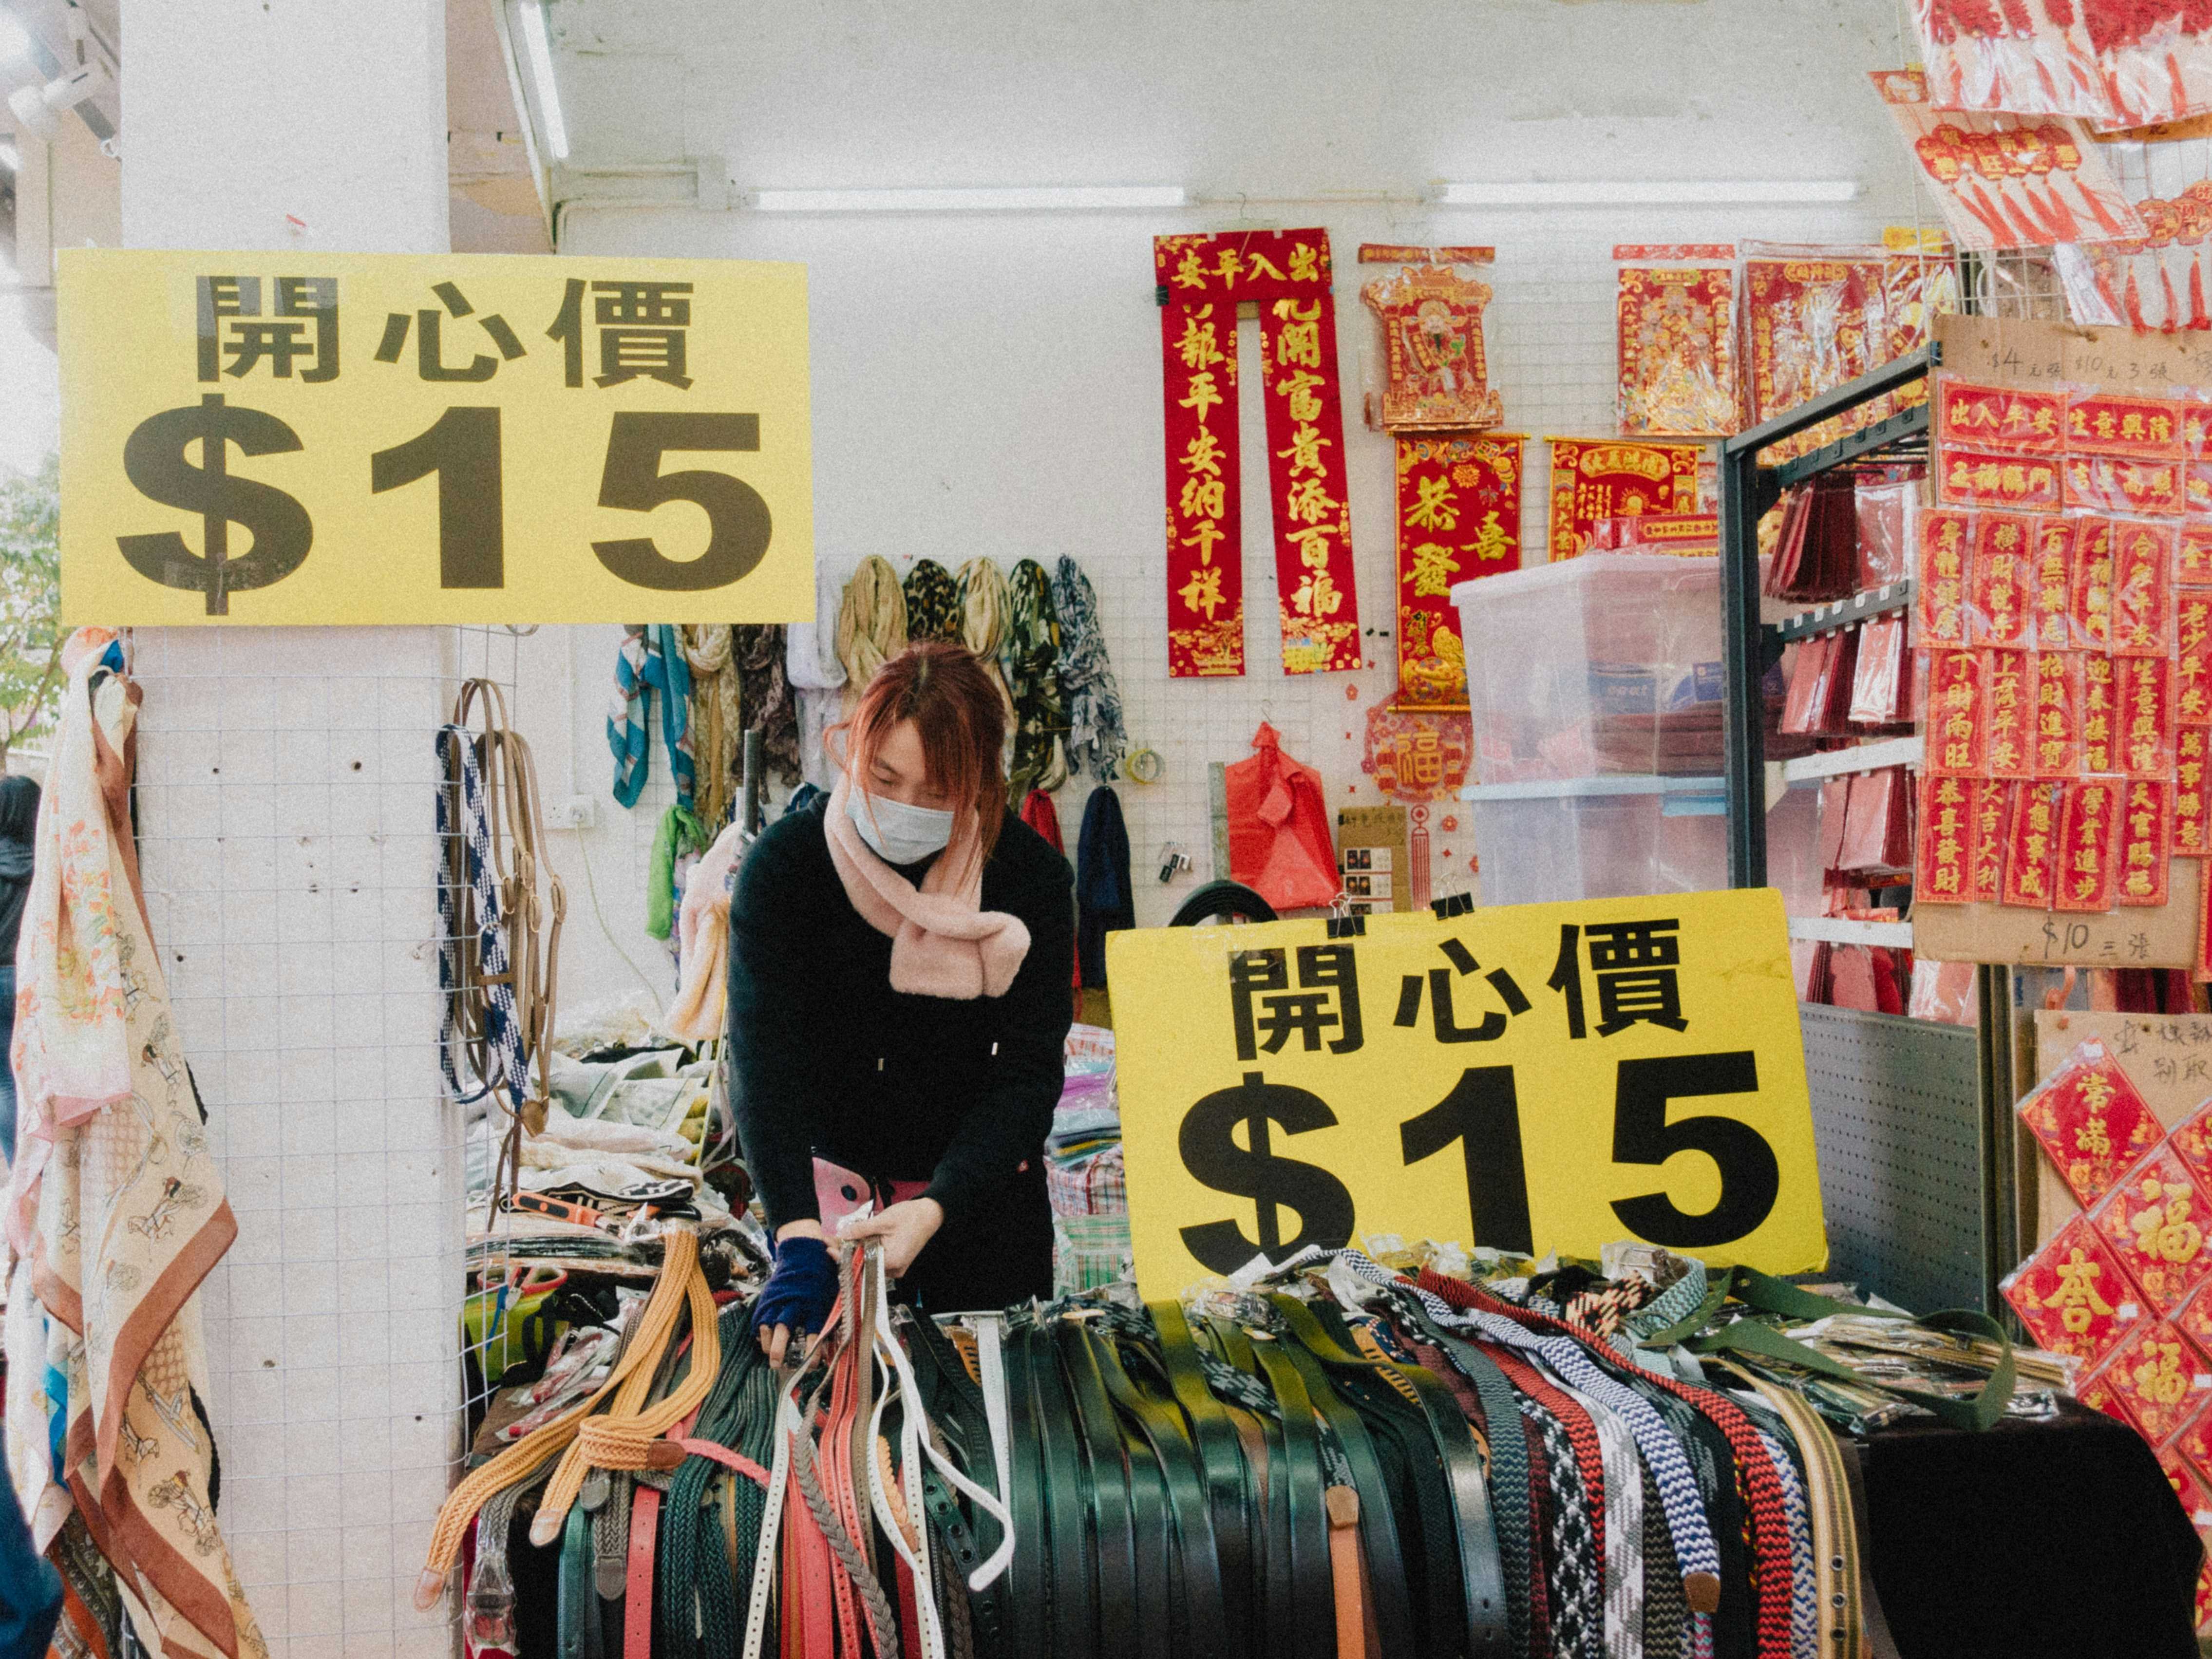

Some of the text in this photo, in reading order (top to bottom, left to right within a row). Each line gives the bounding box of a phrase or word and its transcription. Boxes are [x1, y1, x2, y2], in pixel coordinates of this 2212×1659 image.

[195, 275, 694, 390] 開心價
[1950, 398, 2058, 435] 出入平安
[2069, 408, 2173, 443] 生意興隆
[115, 393, 773, 616] $15
[1931, 519, 1964, 639] 身體健康
[2039, 527, 2069, 642] 百無禁忌
[2039, 653, 2066, 768] 招財進寶
[2084, 658, 2112, 772] 迎春接福
[2130, 659, 2158, 772] 生意興隆
[2176, 602, 2208, 716] 老少平安
[1395, 732, 1442, 783] 福
[2175, 732, 2202, 847] 萬事勝意
[1933, 777, 1966, 894] 恭喜發財
[1977, 778, 2004, 892] 大吉大利
[2020, 783, 2053, 899] 心想事成
[2074, 787, 2104, 901] 學業進步
[2125, 782, 2156, 896] 天官賜福
[1227, 918, 1689, 1061] 開心價
[1178, 1050, 1779, 1277] $15
[2075, 1073, 2116, 1157] 常滿
[2132, 1178, 2202, 1263] 福
[2133, 1340, 2187, 1406] 福
